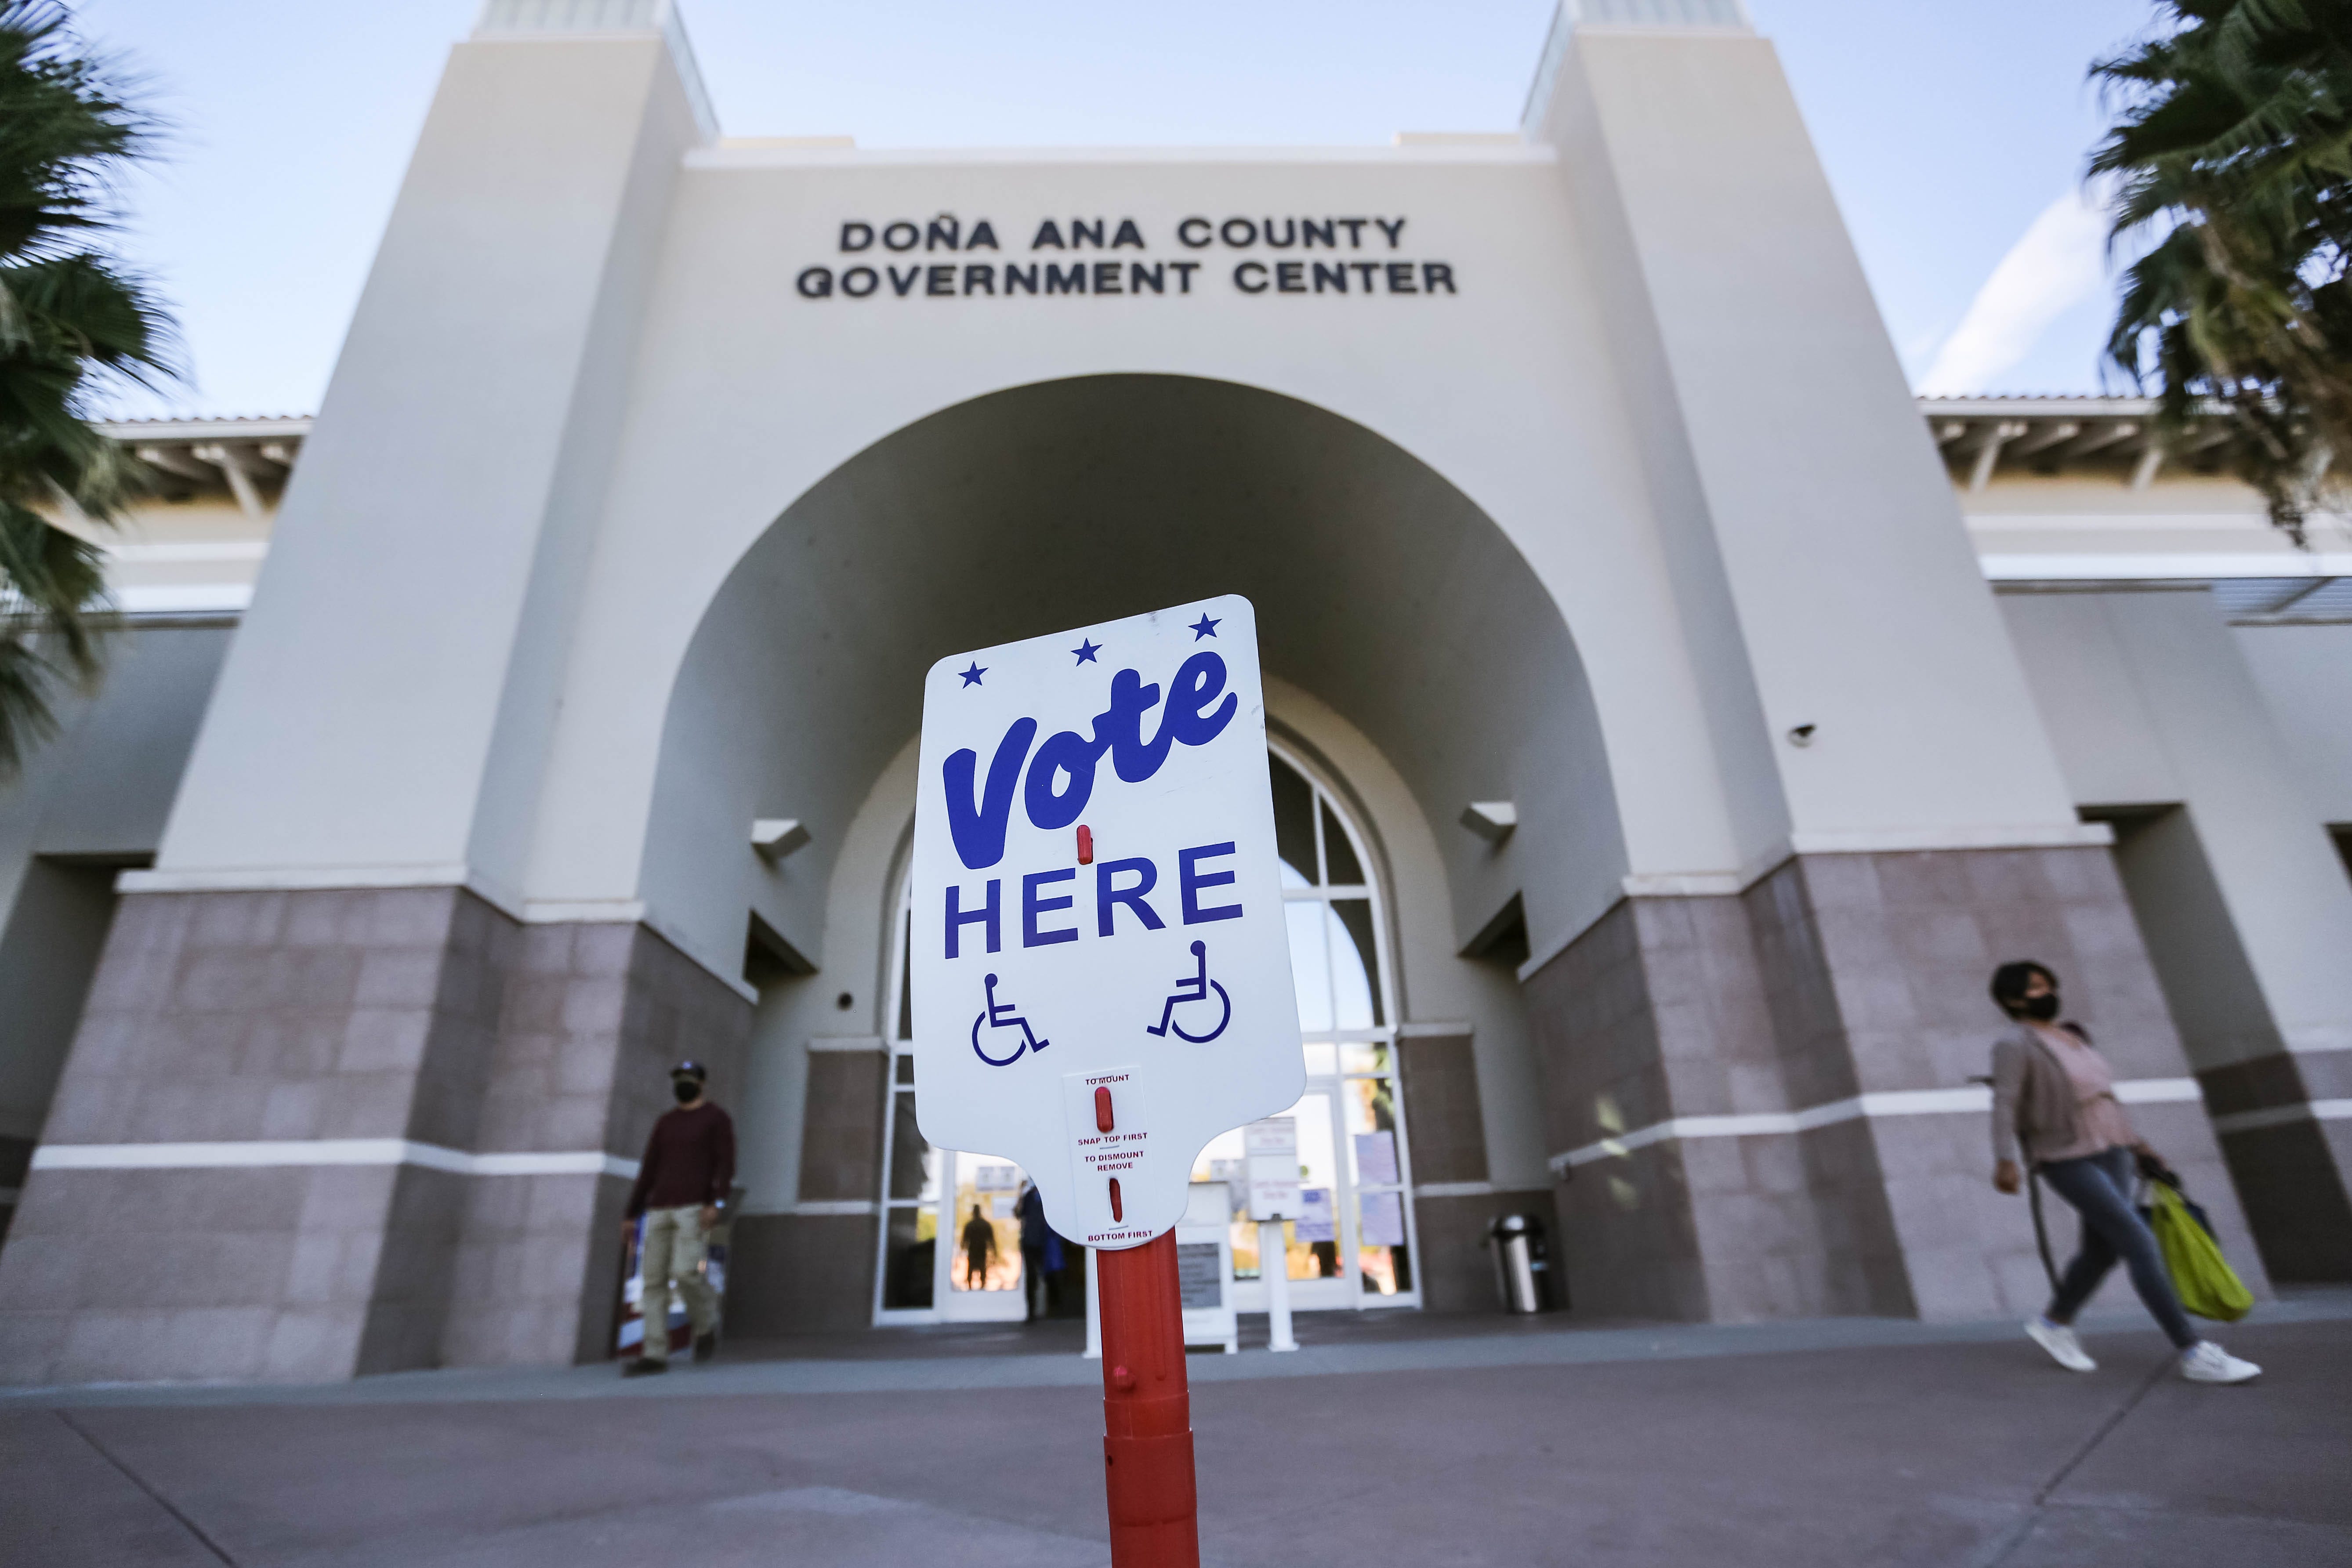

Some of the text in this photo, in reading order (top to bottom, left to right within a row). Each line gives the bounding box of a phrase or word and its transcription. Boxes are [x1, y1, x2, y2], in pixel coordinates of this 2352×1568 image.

[839, 212, 1406, 252] DOÑA ANA COUNTY
[796, 261, 1457, 299] GOVERNMENT CENTER
[942, 651, 1238, 870] Vote
[945, 841, 1243, 959] HERE
[1099, 1074, 1129, 1084] MOUNT
[1078, 1137, 1101, 1146] SNAP
[1123, 1132, 1148, 1141] FIRST
[1098, 1151, 1144, 1161] DISMOUNT
[1097, 1162, 1133, 1172] REMOVE
[1088, 1230, 1152, 1242] BOTTOM FIRST
